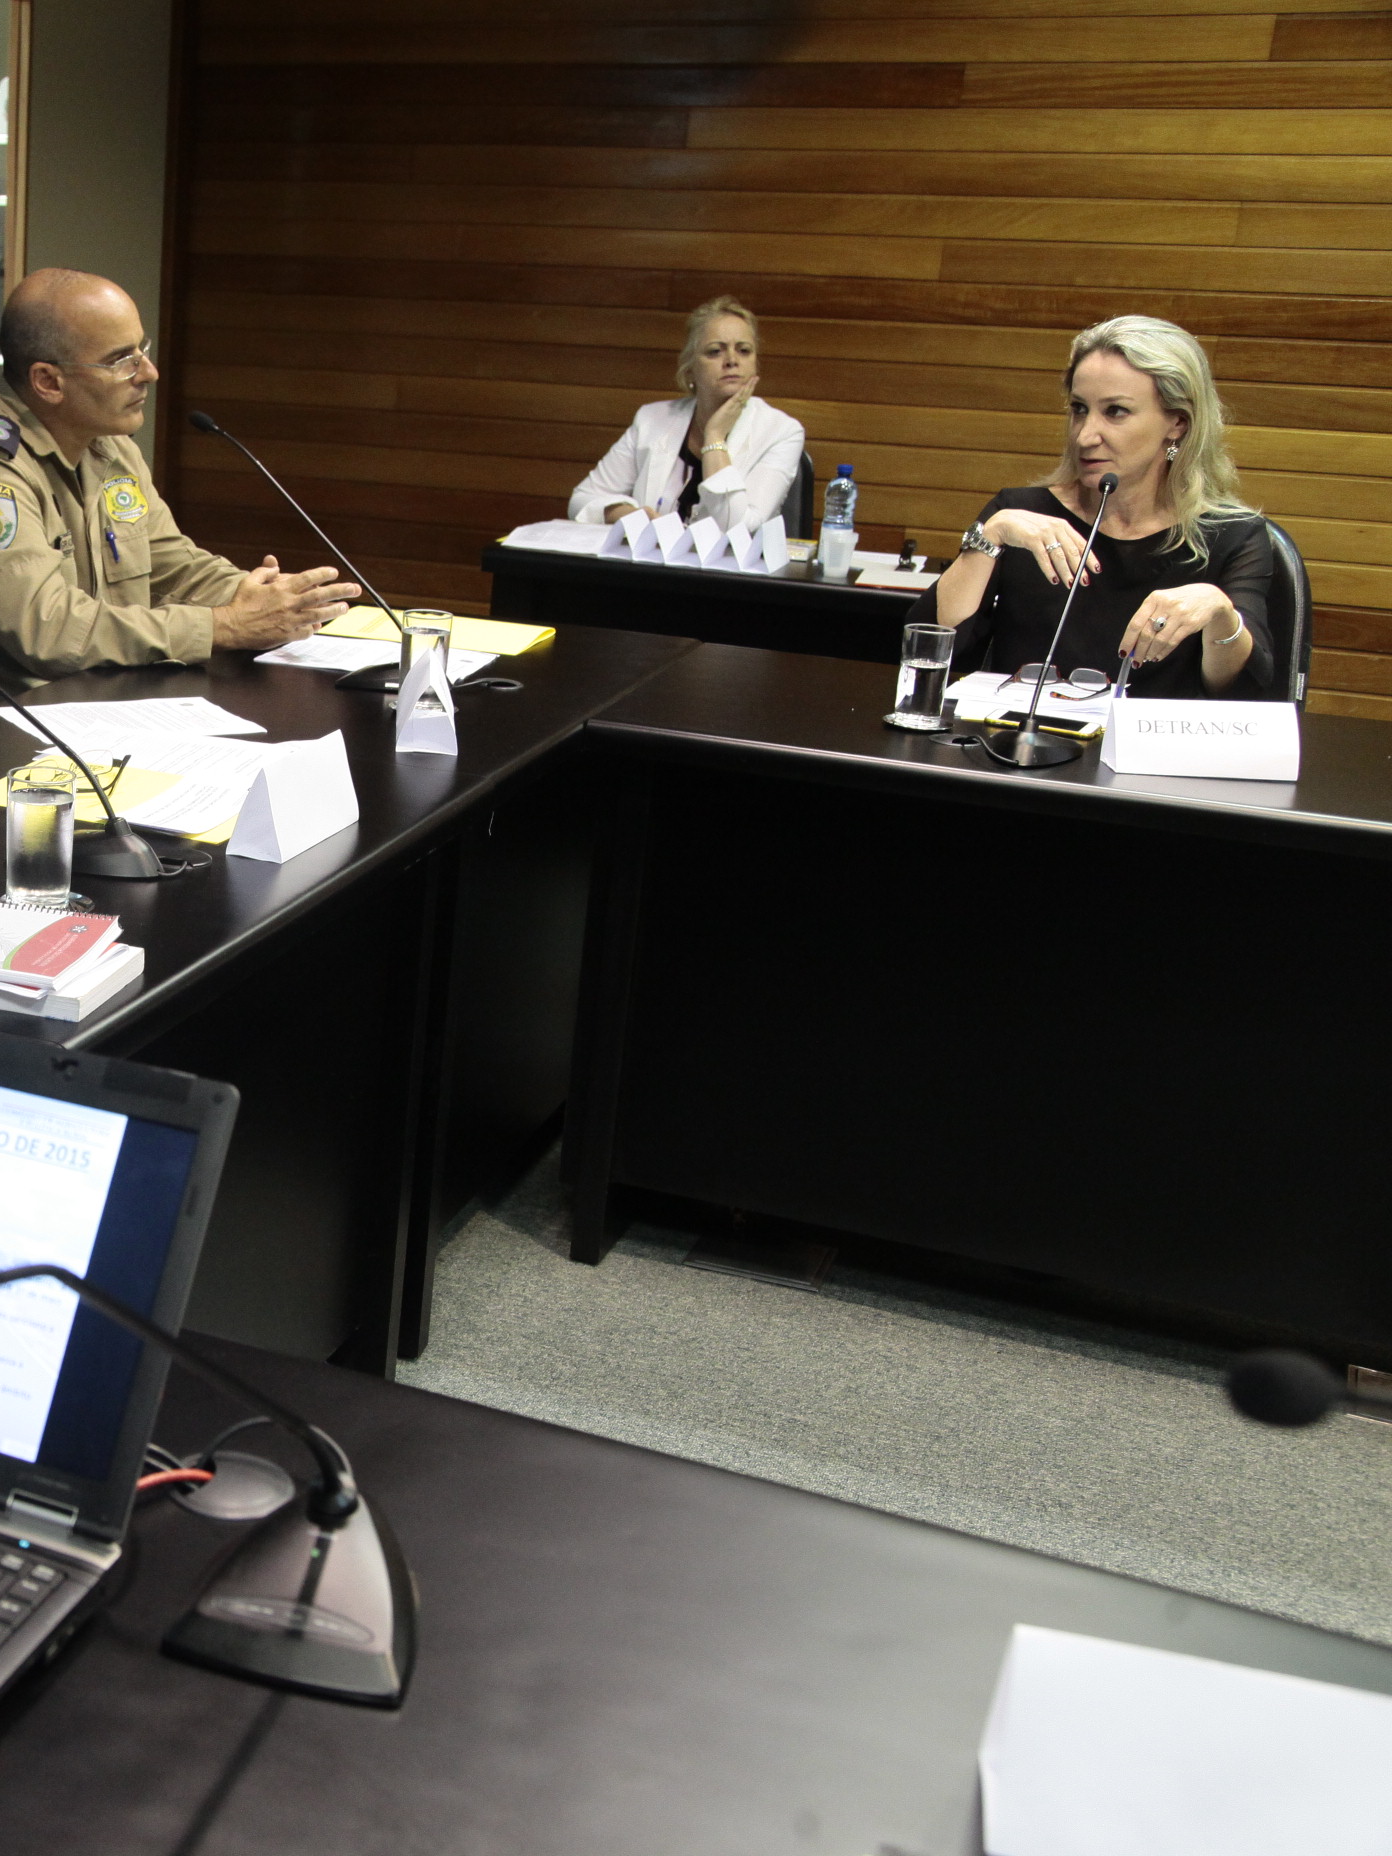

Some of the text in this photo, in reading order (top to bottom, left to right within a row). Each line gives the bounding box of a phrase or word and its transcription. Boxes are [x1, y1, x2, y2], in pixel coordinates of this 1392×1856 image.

[1138, 719, 1258, 736] DETRAN/SC
[13, 1134, 41, 1156] DE
[43, 1141, 92, 1169] 2015
